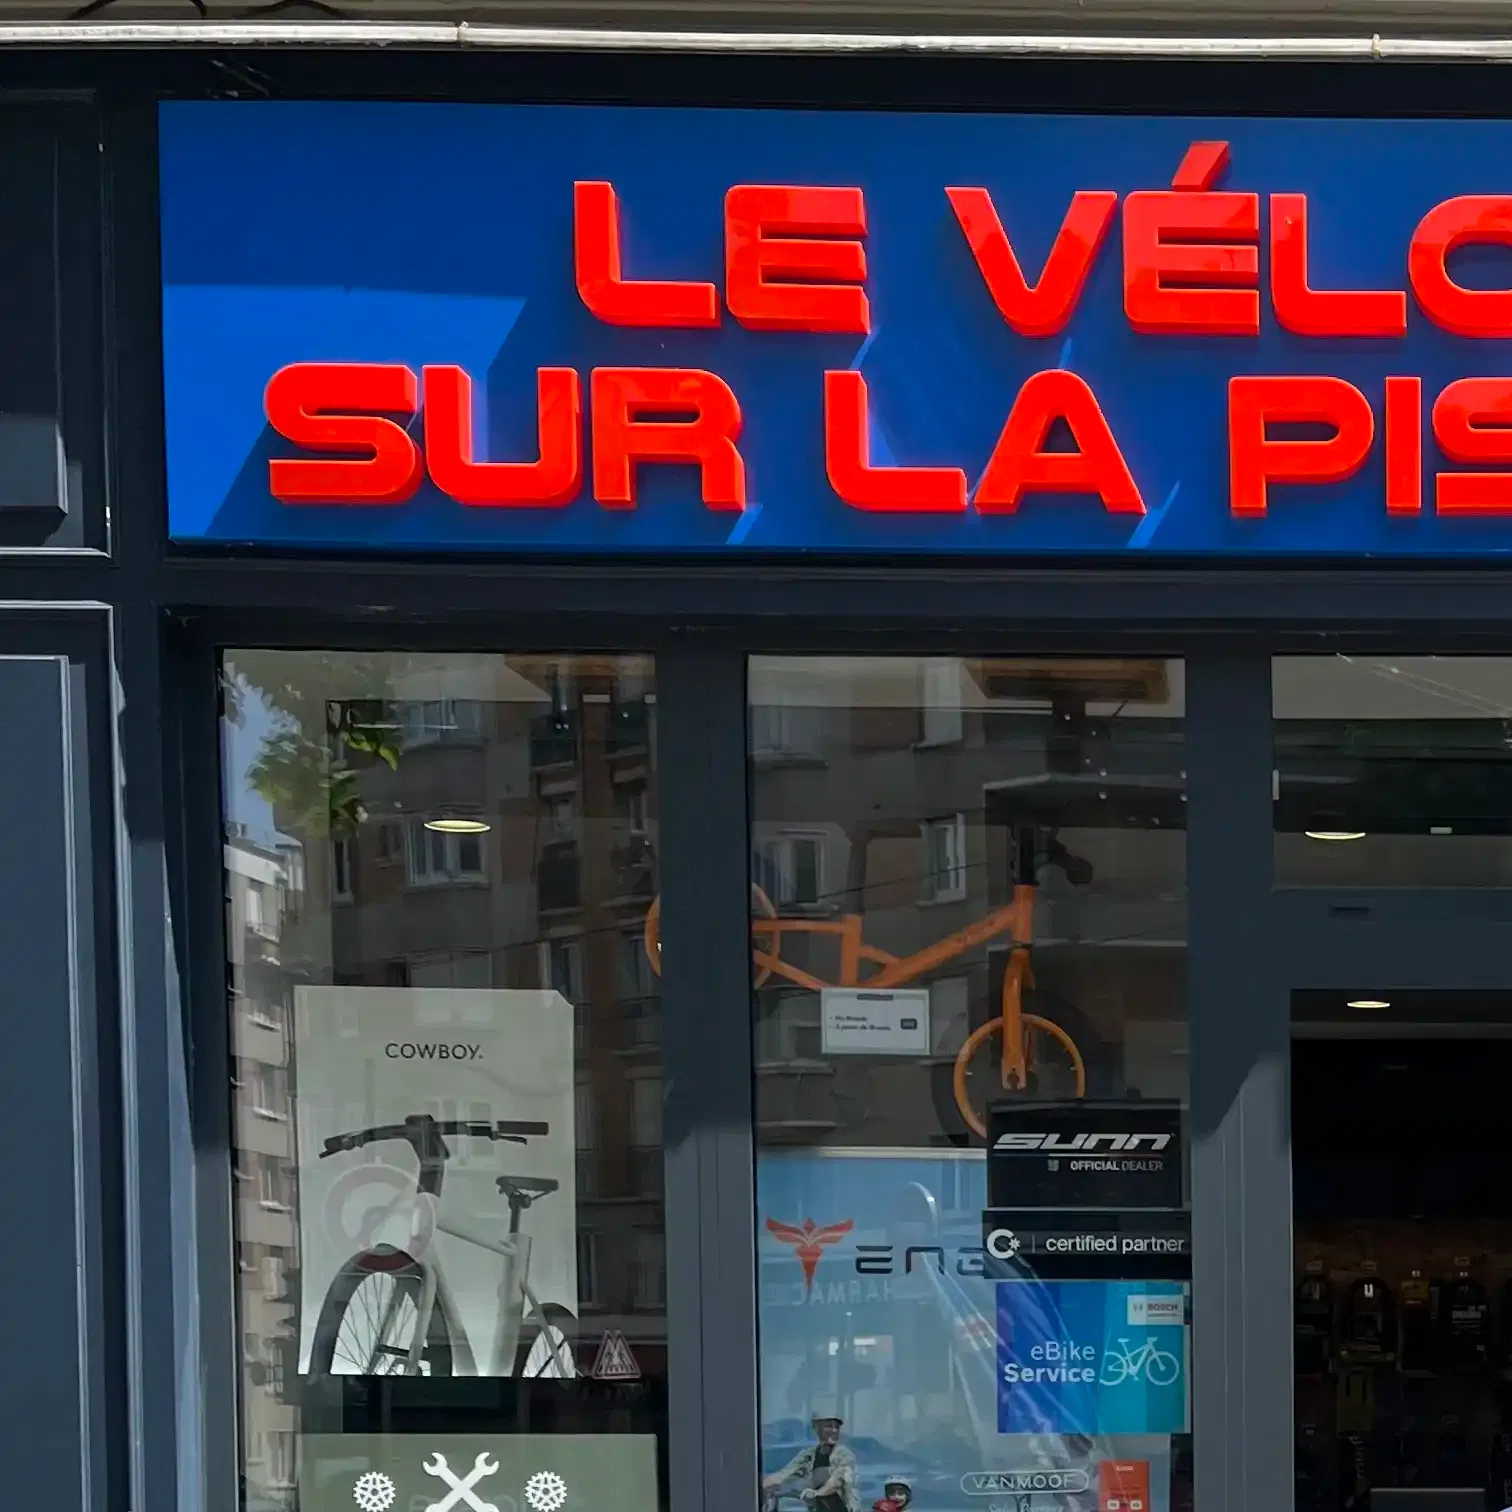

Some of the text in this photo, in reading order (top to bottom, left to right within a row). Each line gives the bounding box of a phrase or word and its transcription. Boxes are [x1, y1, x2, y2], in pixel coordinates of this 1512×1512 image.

[573, 180, 870, 334] LE
[262, 361, 748, 512] SUR
[822, 368, 1147, 515] LA
[1070, 1160, 1163, 1171] OFFICIAL DEALER
[1046, 1235, 1117, 1252] certified
[1122, 1237, 1185, 1254] partner
[1030, 1340, 1096, 1362] eBike
[1003, 1364, 1096, 1384] Service
[971, 1473, 1078, 1490] VANMOOF
